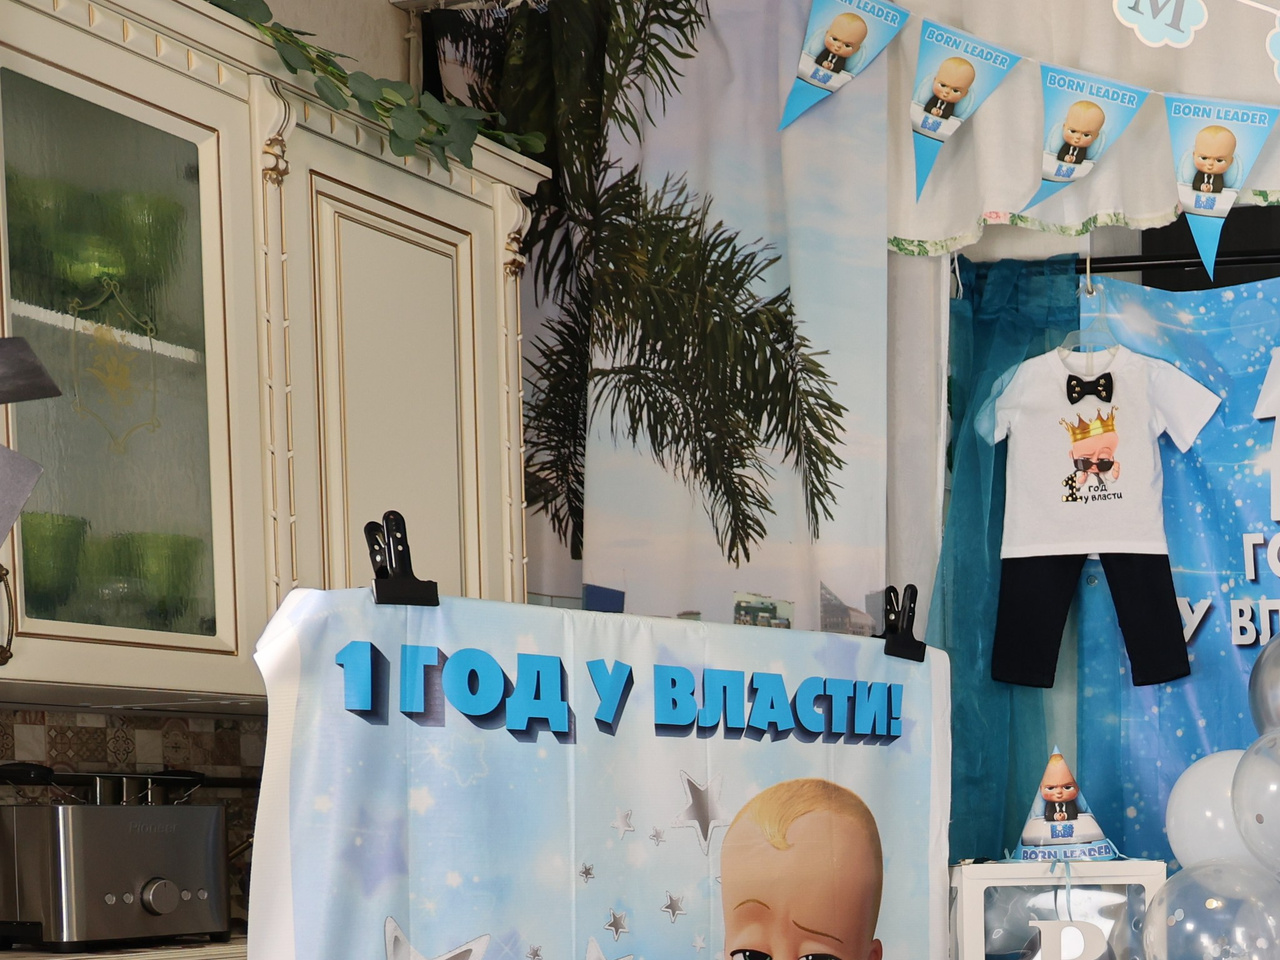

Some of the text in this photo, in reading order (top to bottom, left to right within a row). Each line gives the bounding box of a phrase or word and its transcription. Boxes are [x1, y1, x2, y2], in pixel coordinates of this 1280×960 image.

[926, 27, 1010, 68] BORN LEADER
[1048, 73, 1138, 107] BORN LEADER
[1172, 103, 1269, 126] BORN LEADER
[1177, 596, 1212, 643] У
[336, 641, 904, 743] 1 ГОД У ВЛАСТИ!
[130, 820, 178, 833] Pioneer
[1022, 844, 1112, 861] BORN LEADER
